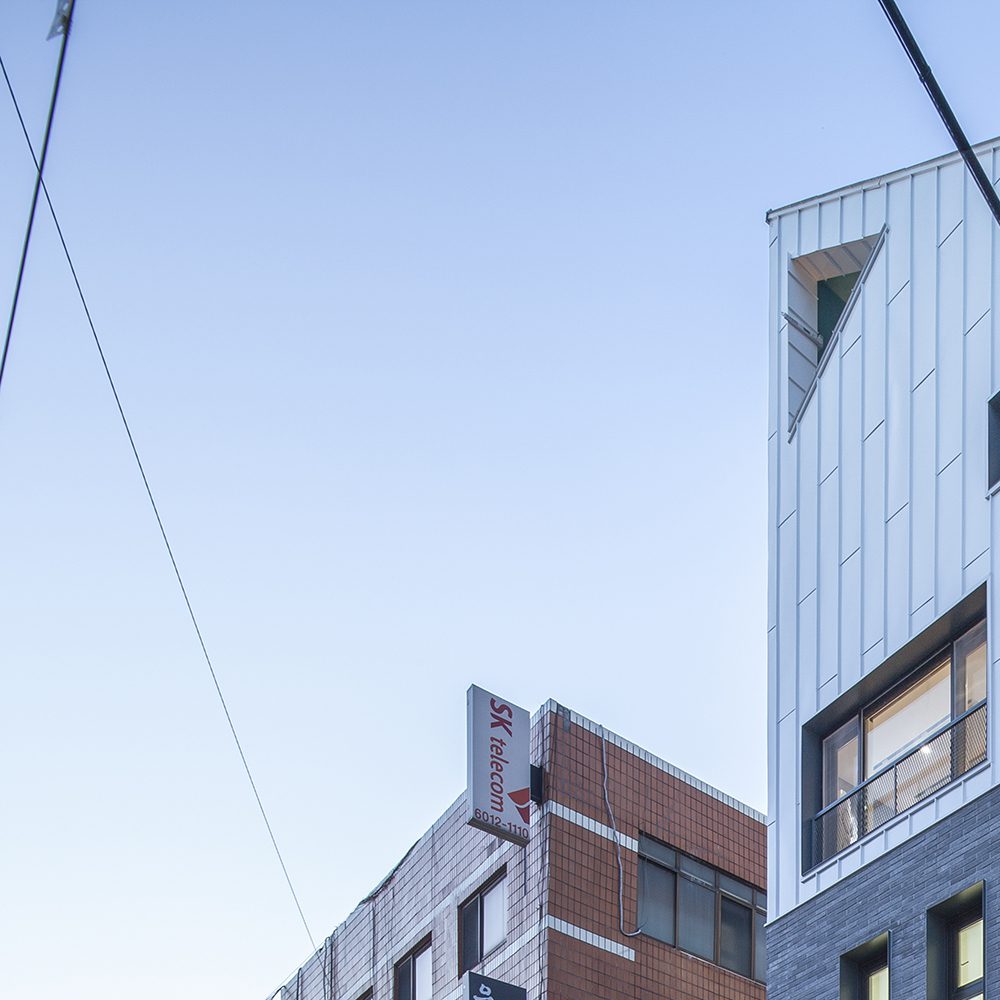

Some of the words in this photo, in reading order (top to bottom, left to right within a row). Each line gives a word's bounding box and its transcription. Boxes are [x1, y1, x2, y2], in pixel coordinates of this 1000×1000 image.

[490, 697, 513, 738] SK
[490, 735, 510, 813] telecom
[474, 808, 529, 840] 6012-1110
